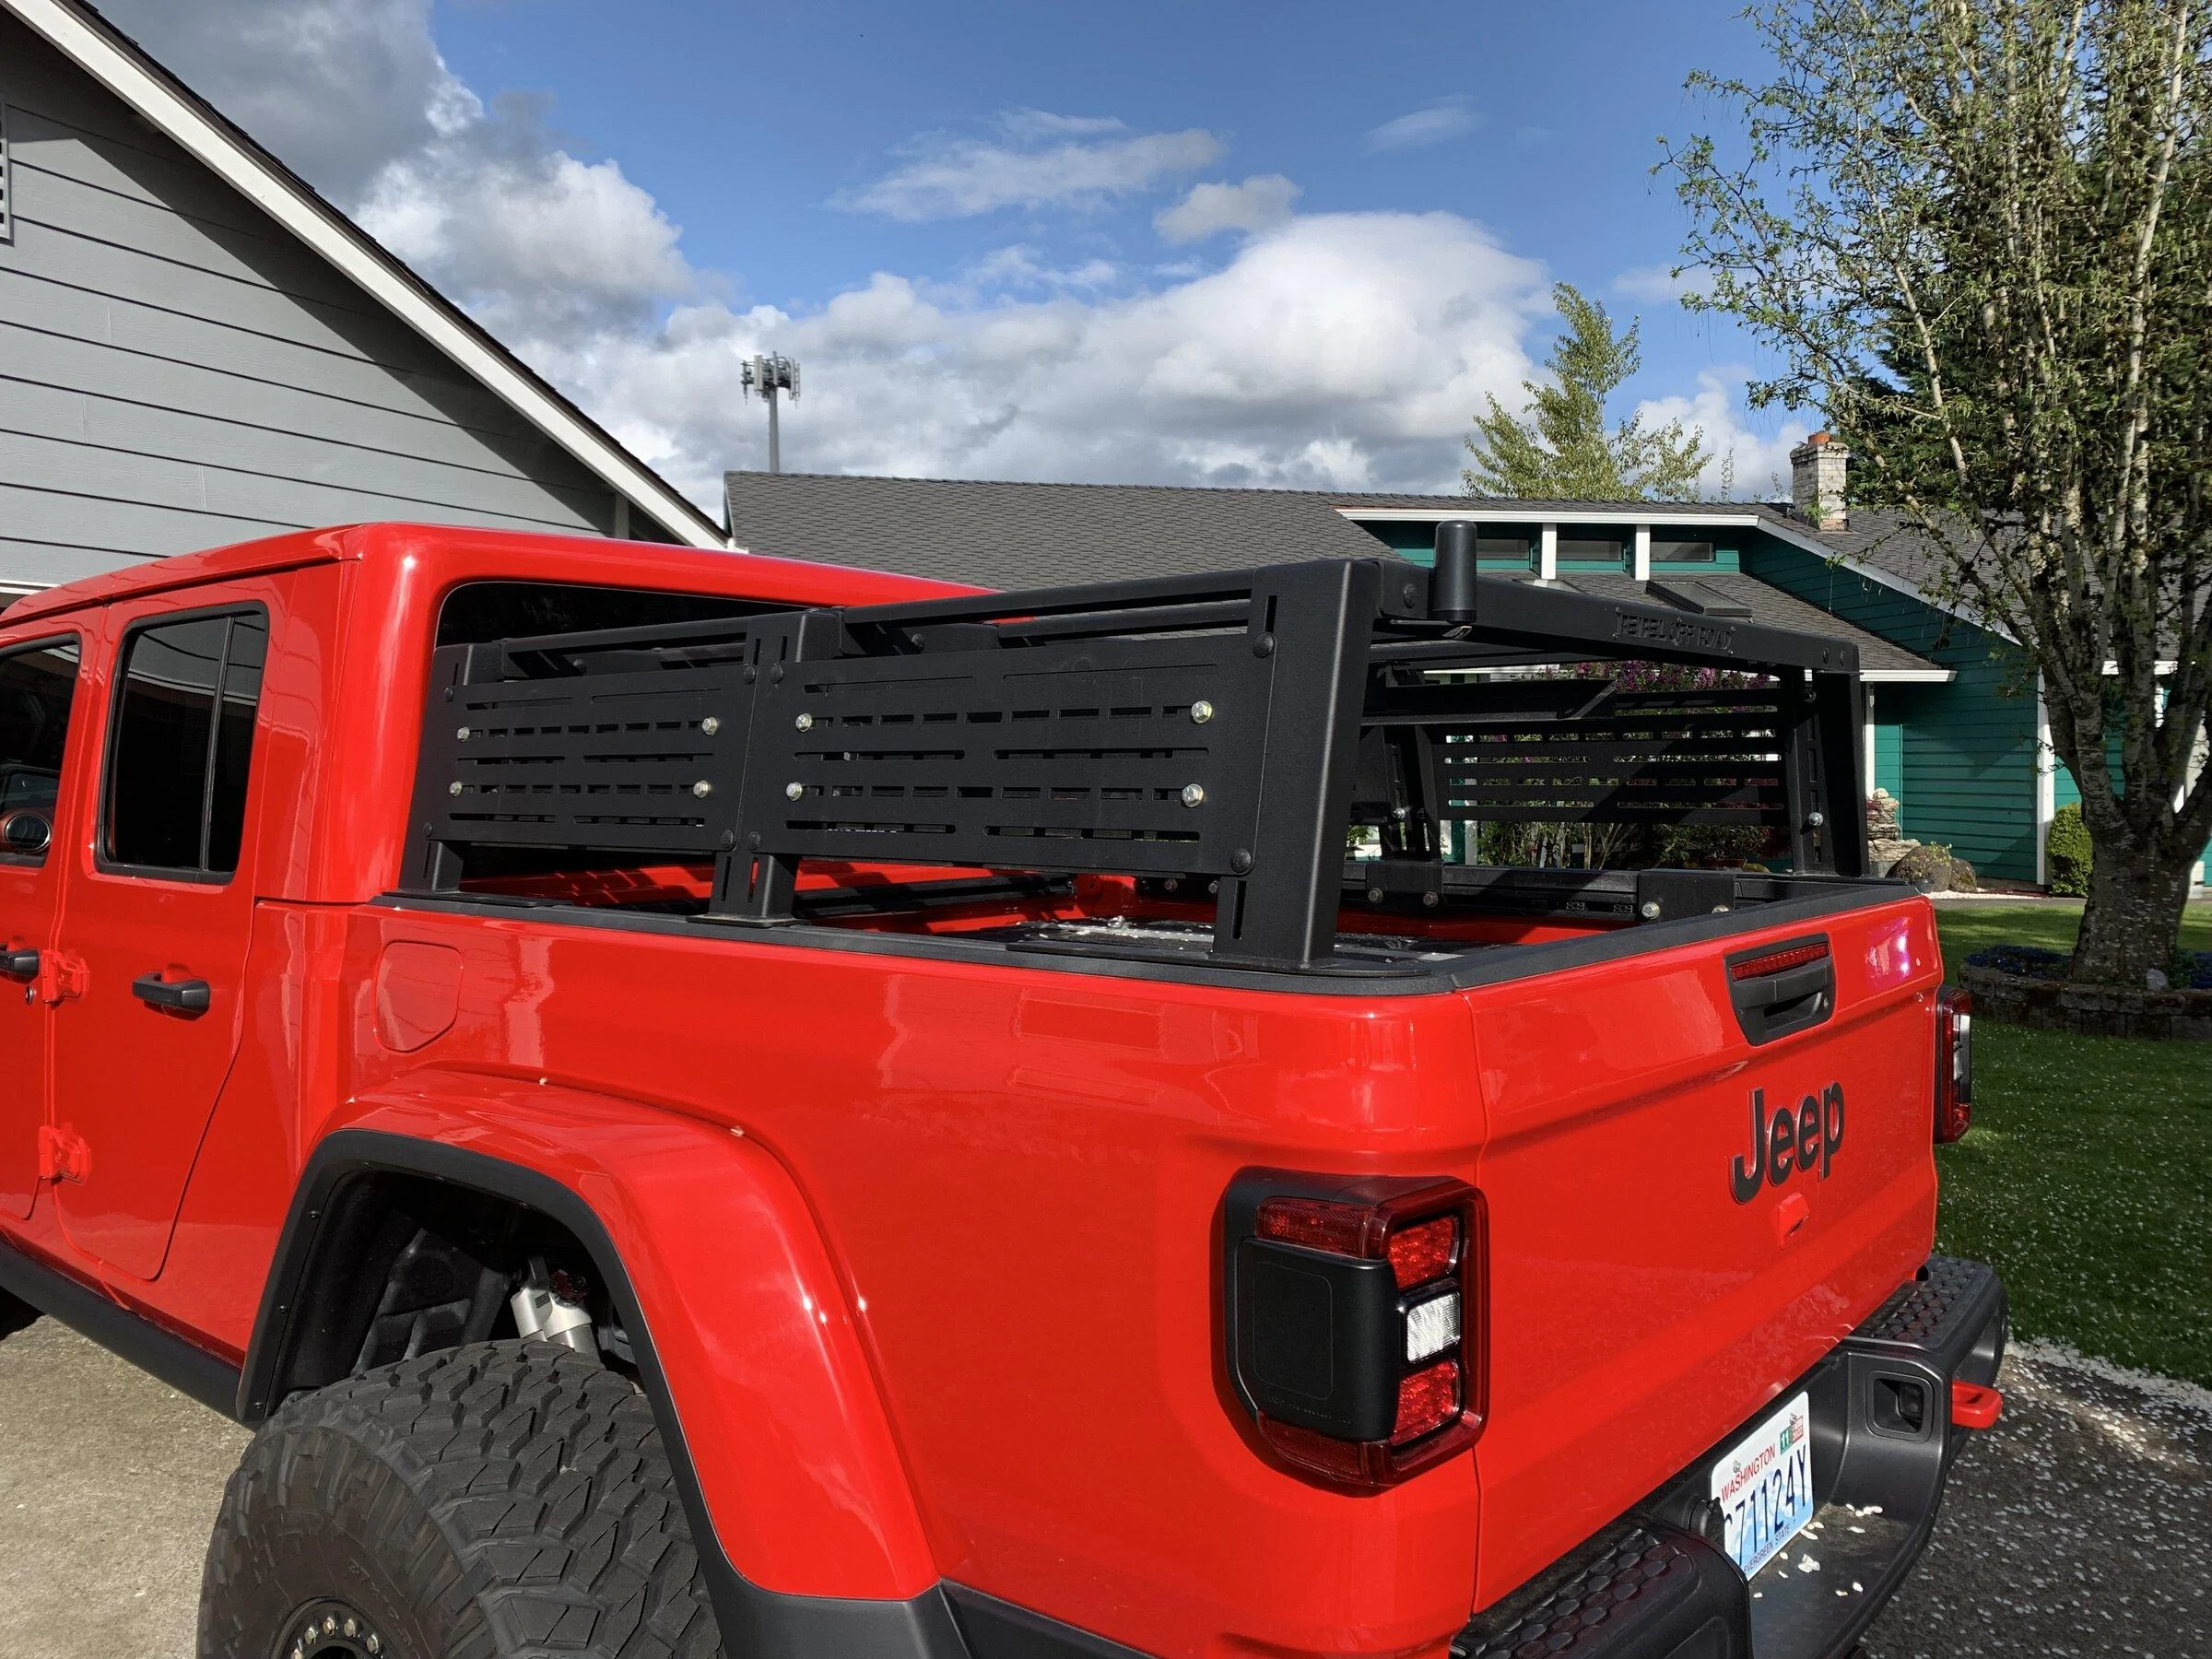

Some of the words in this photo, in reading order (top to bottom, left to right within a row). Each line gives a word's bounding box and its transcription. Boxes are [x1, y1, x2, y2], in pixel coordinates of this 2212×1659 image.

[1728, 1081, 1845, 1205] Jeep
[1781, 1429, 1790, 1449] 11
[1721, 1442, 1776, 1503] WASHINGTON
[1743, 1540, 1773, 1572] EVERGREEN
[1774, 1524, 1790, 1546] STATE
